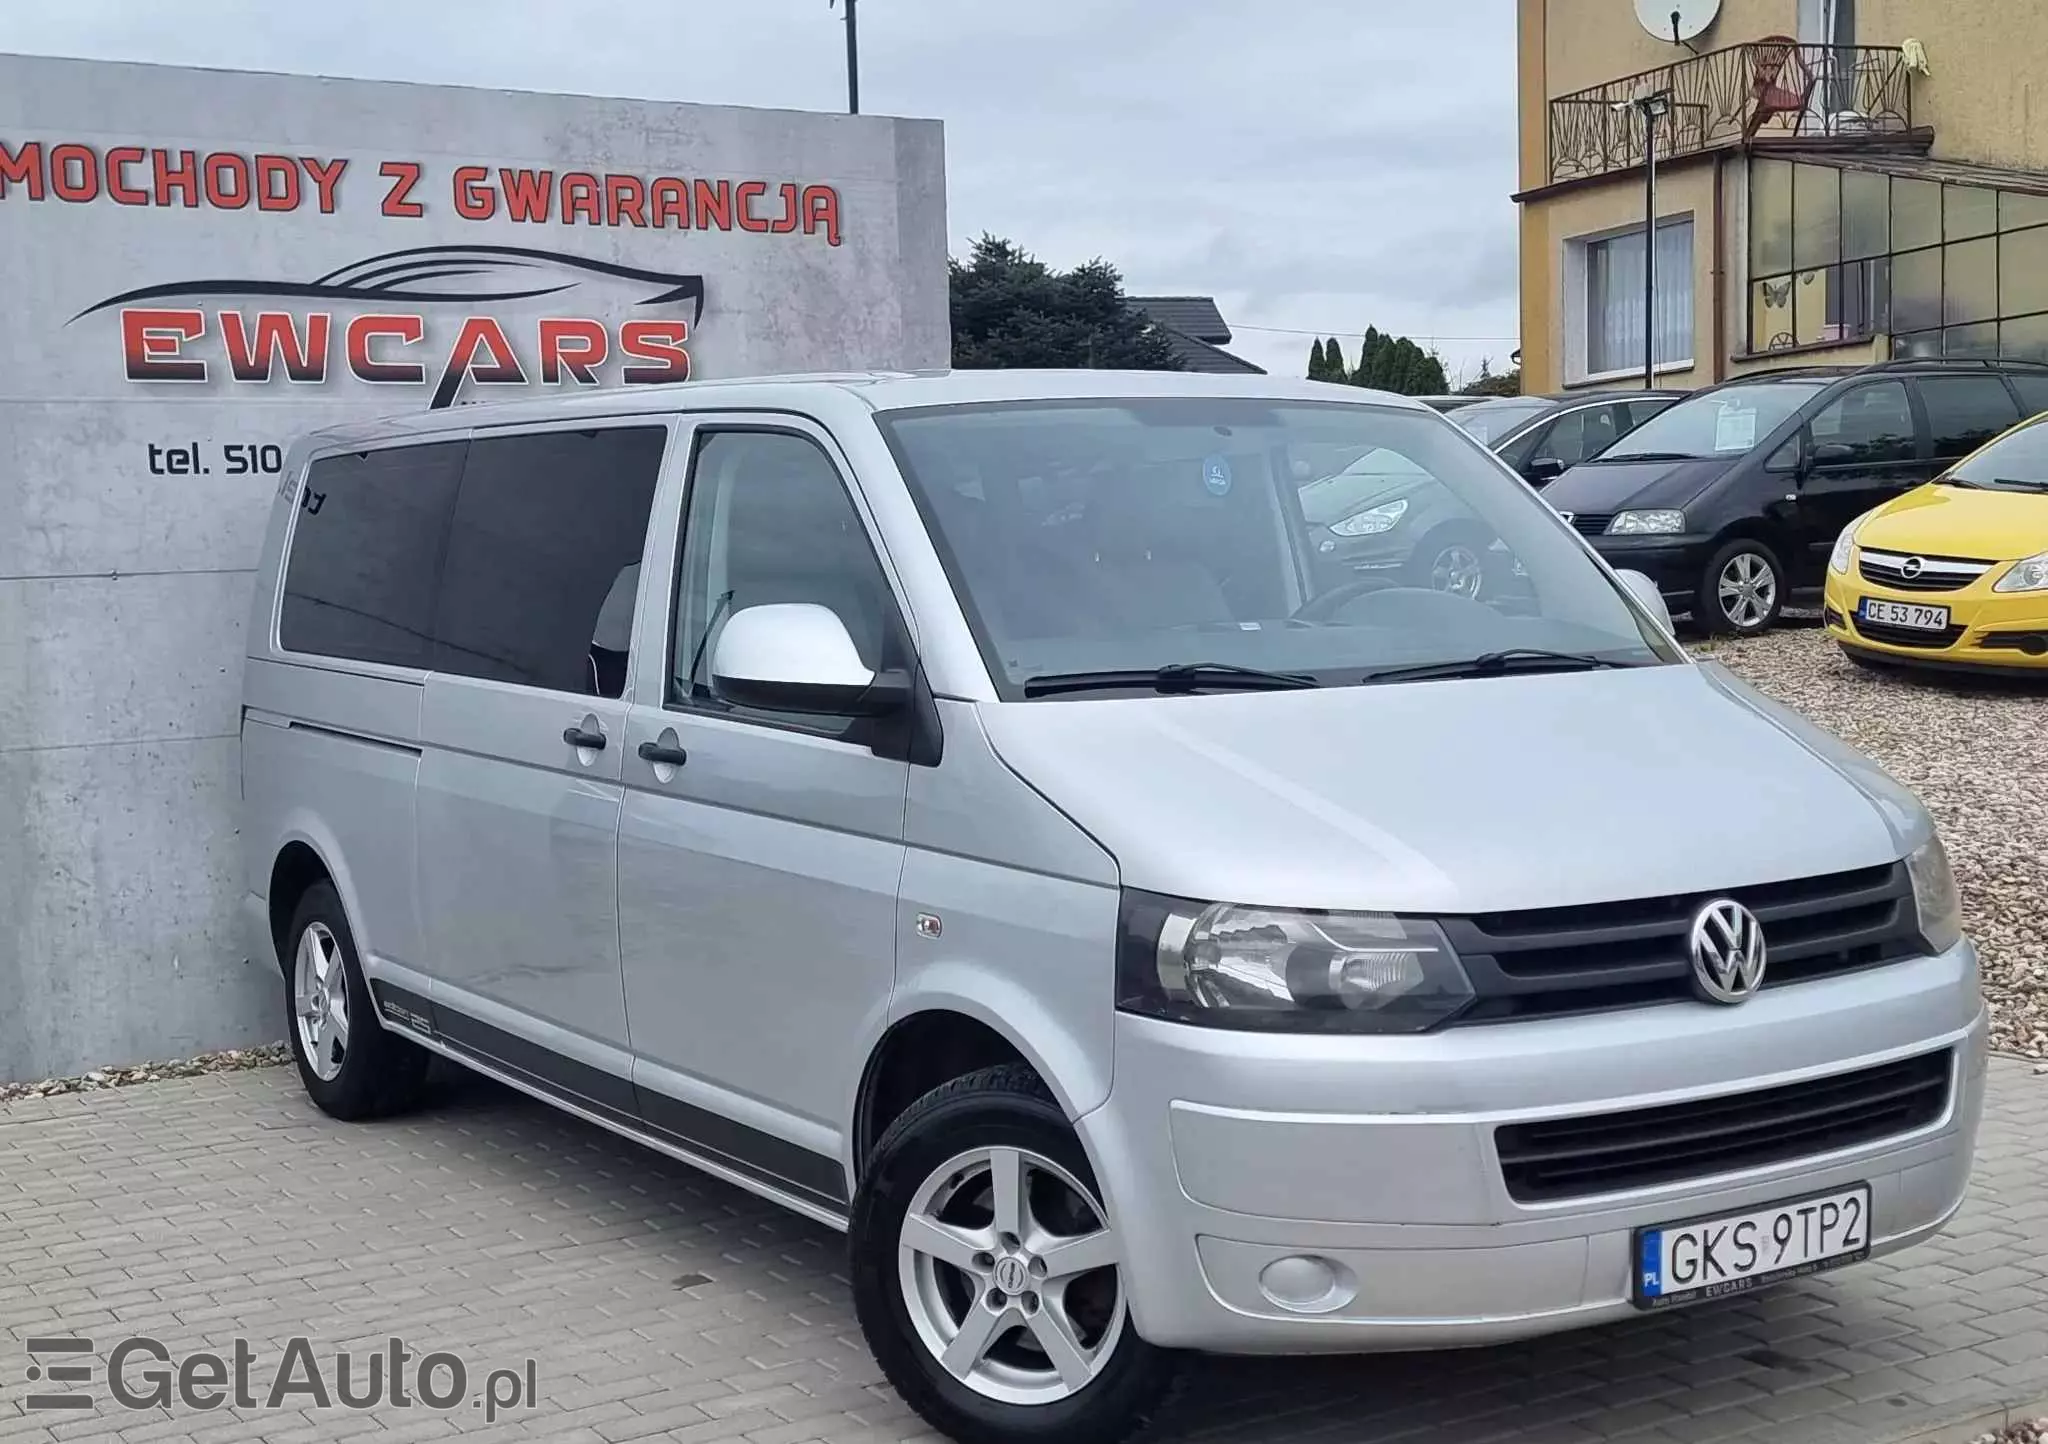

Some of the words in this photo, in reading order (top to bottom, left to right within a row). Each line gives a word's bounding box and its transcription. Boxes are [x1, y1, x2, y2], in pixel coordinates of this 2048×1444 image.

[0, 142, 348, 214] MOCHODY
[379, 161, 424, 218] Z
[453, 166, 842, 247] GWARANCJĄ
[120, 308, 691, 409] EWCARS
[148, 443, 210, 474] tel.
[224, 445, 282, 474] 510
[1868, 602, 1886, 620] CE
[1890, 605, 1909, 622] 53
[1914, 608, 1943, 627] 794
[1671, 1221, 1757, 1285] GKS
[1773, 1197, 1861, 1265] 9TP2
[1644, 1272, 1659, 1288] PL
[1705, 1277, 1753, 1298] EWCARS
